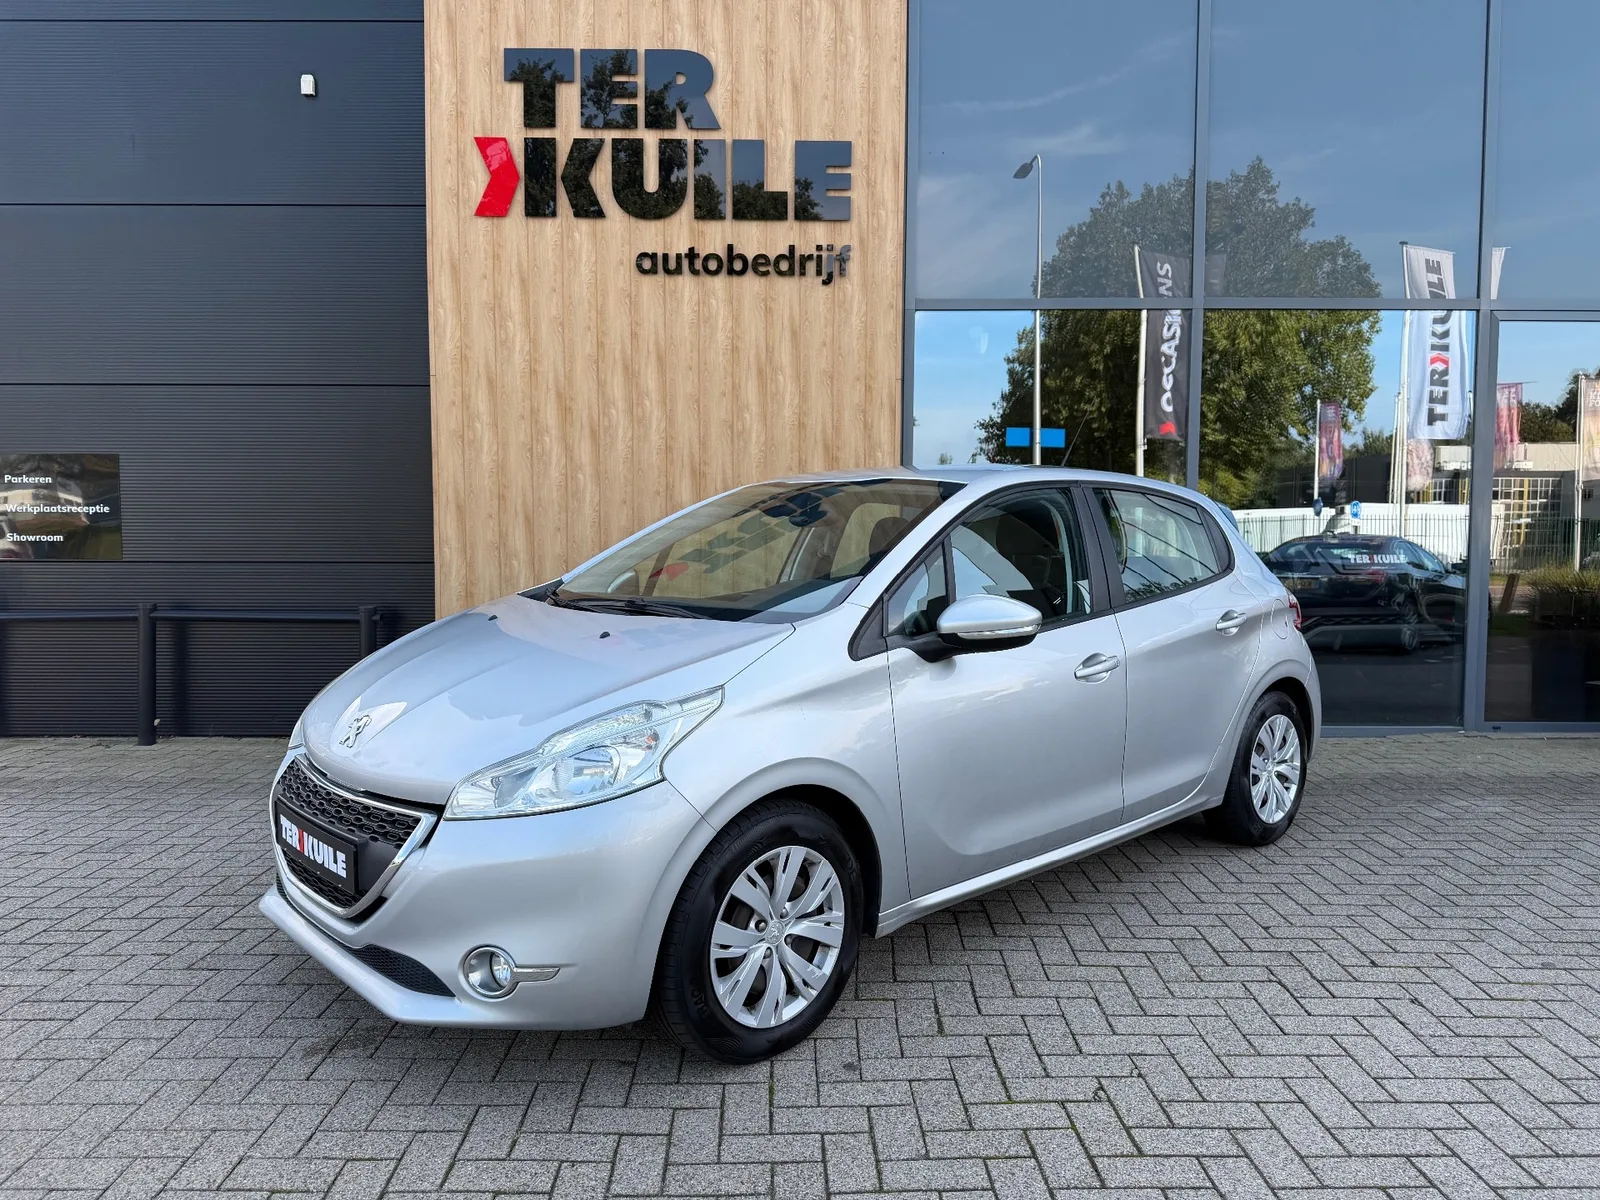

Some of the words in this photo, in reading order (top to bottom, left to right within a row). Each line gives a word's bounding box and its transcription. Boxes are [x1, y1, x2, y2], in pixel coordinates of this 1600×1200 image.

[504, 48, 721, 130] TER
[524, 137, 852, 221] KUILE
[636, 244, 852, 285] autobedrijf
[4, 474, 52, 484] Parkeren
[5, 503, 110, 515] Werkplaatsreceptie
[6, 532, 64, 542] Showroom
[280, 814, 300, 851] TER
